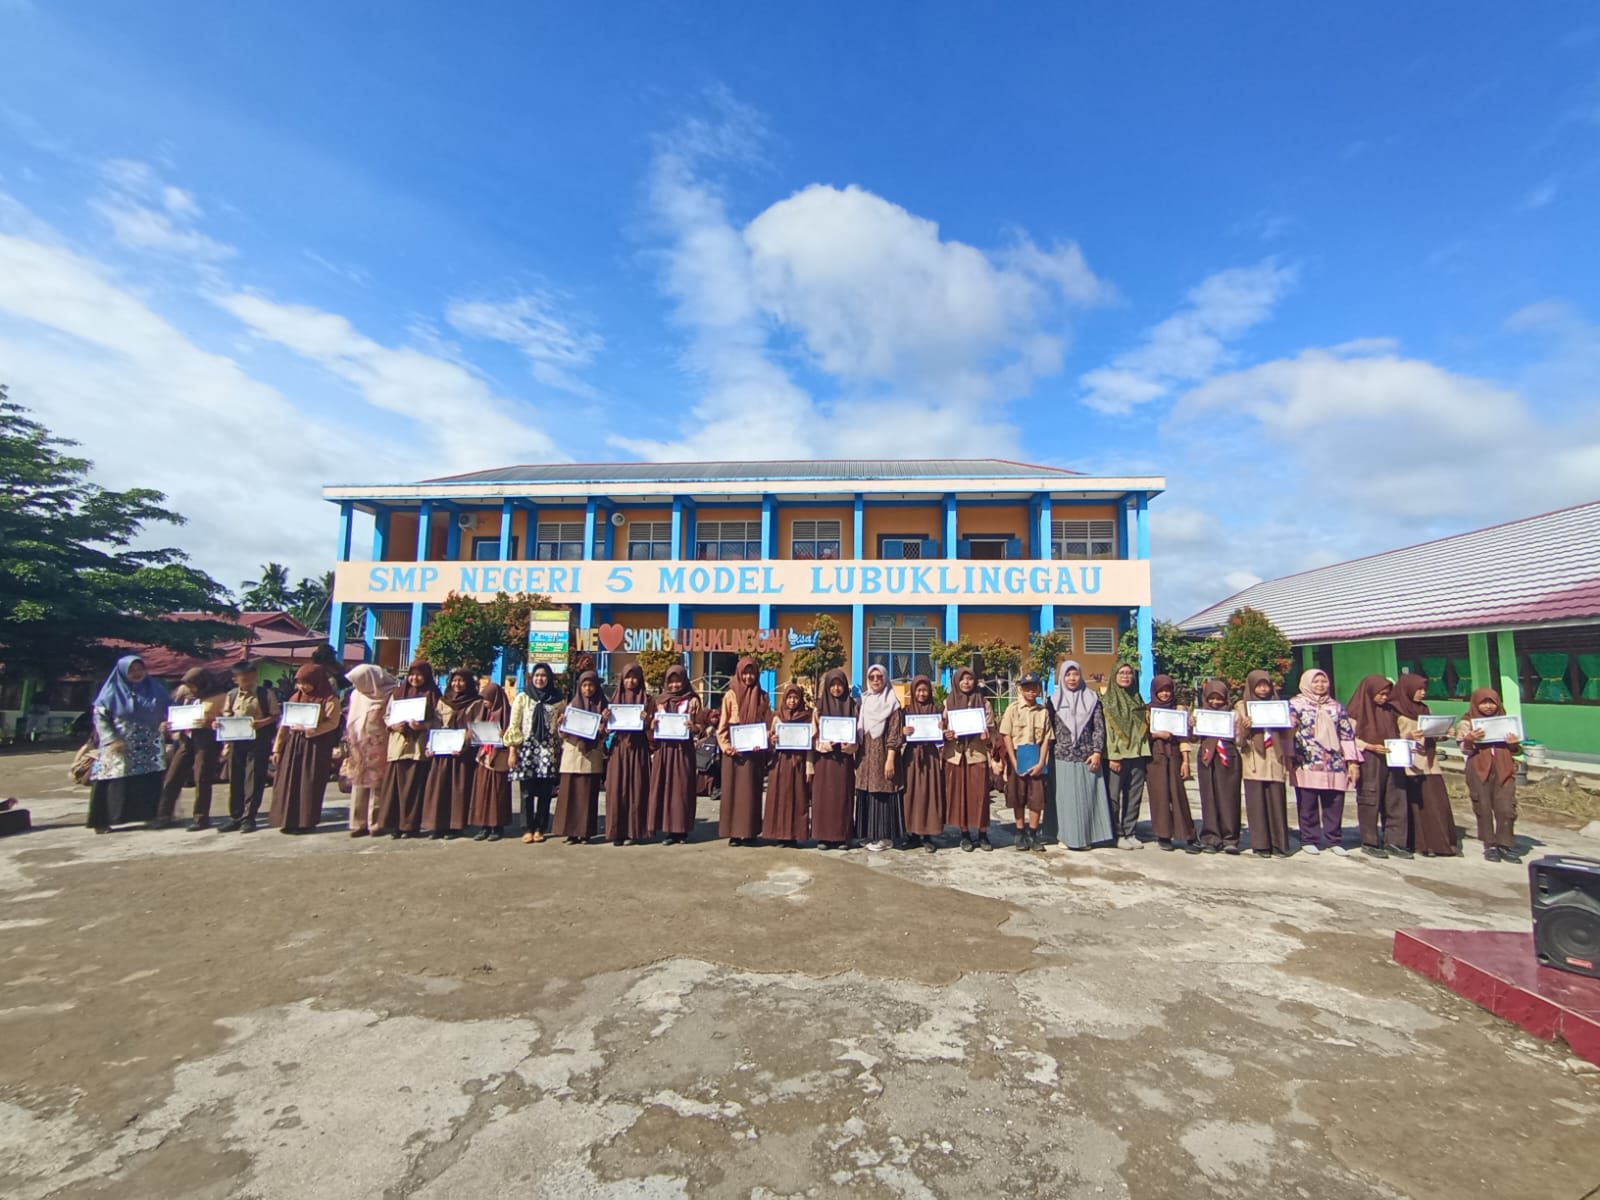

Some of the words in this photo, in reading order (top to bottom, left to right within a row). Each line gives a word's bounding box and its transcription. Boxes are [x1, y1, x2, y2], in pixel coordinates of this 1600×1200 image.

[368, 566, 438, 592] SMP
[460, 566, 581, 593] NEGERI
[607, 566, 633, 592] 5
[658, 566, 784, 593] MODEL
[811, 565, 1101, 594] LUBUKLINGGAU
[576, 628, 599, 651] WE
[624, 628, 662, 651] SMPN
[663, 628, 674, 651] 5
[674, 628, 787, 653] LUBUKLINGGAU
